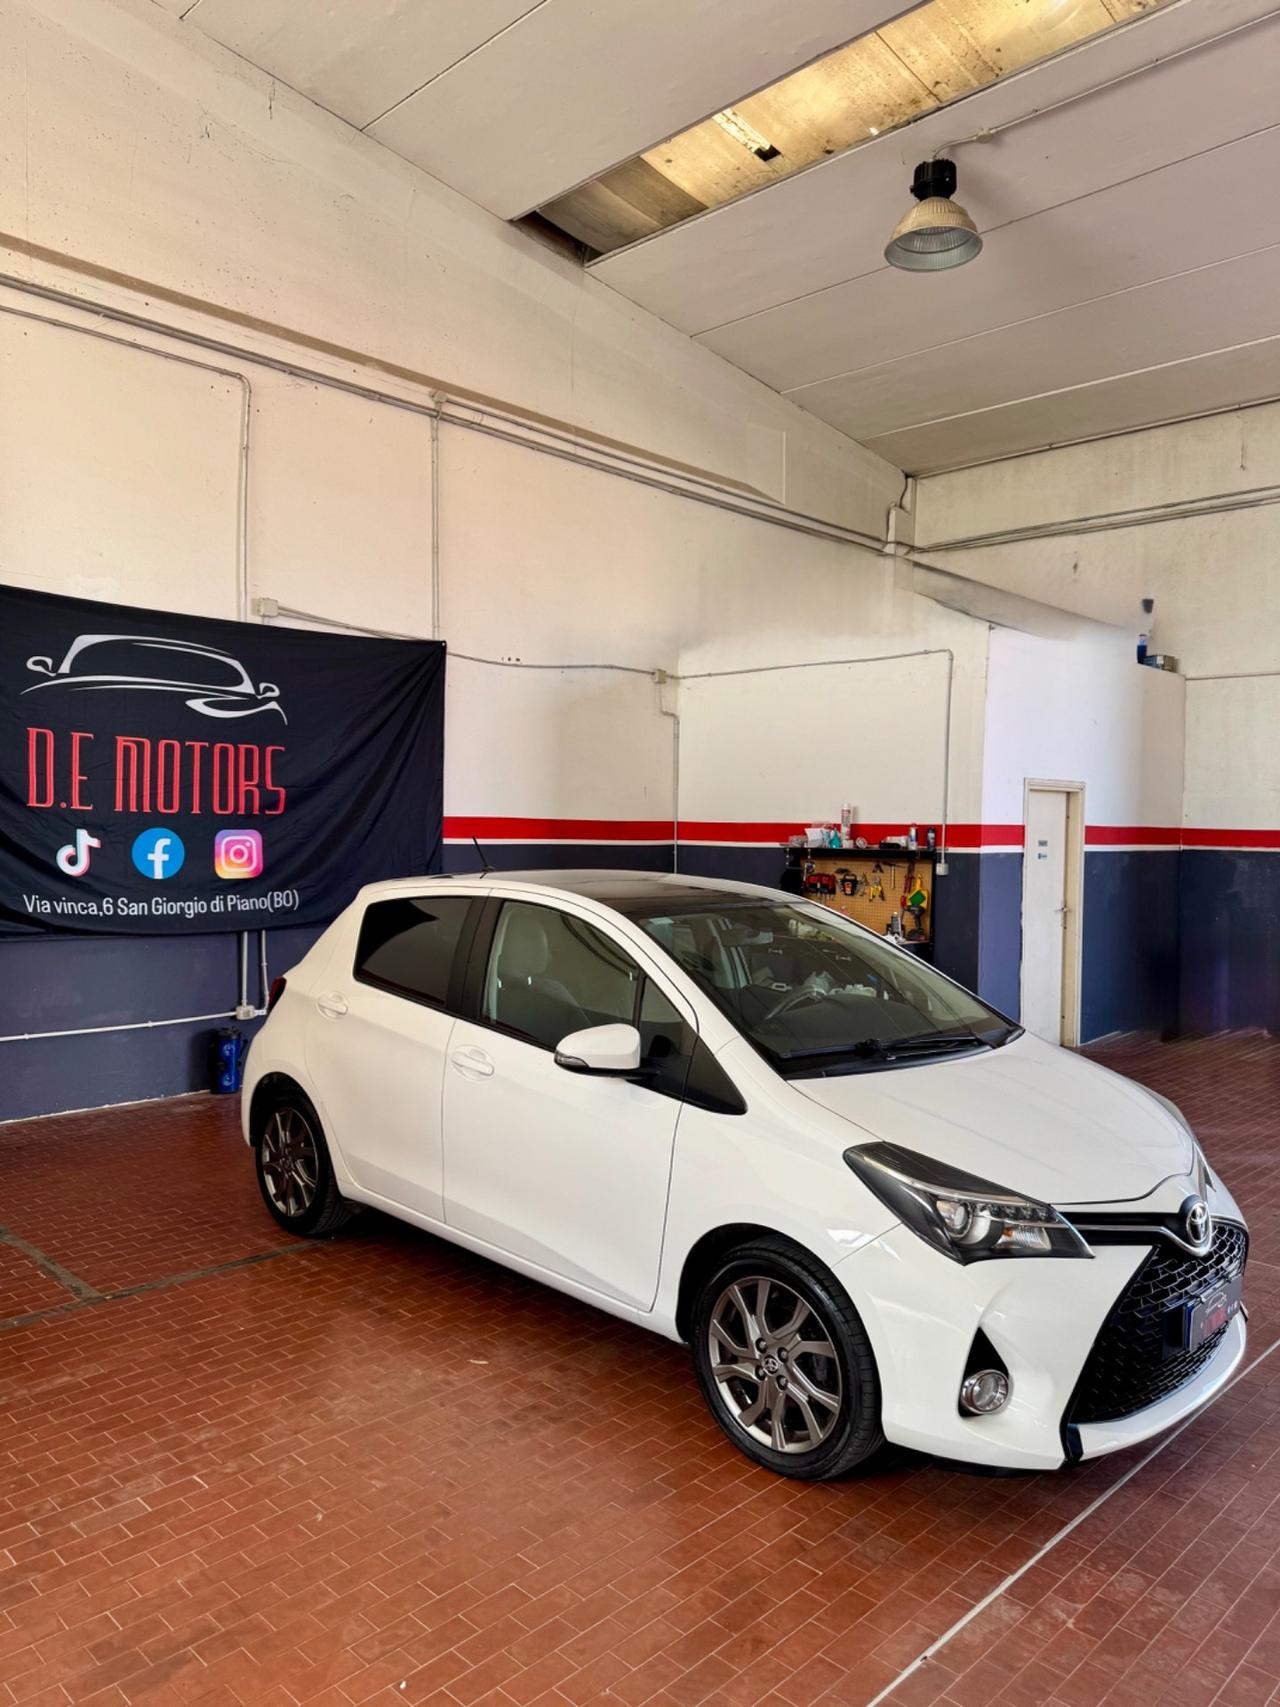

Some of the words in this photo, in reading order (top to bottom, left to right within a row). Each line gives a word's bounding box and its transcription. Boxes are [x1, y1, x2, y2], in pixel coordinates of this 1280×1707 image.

[27, 728, 95, 810] D.E
[114, 736, 287, 815] MOTORS
[22, 894, 51, 913] Via
[53, 897, 113, 917] vinca,6
[117, 897, 148, 915] San
[151, 896, 207, 918] Giorgio
[210, 895, 224, 912] di
[227, 889, 299, 913] Piano(BO)
